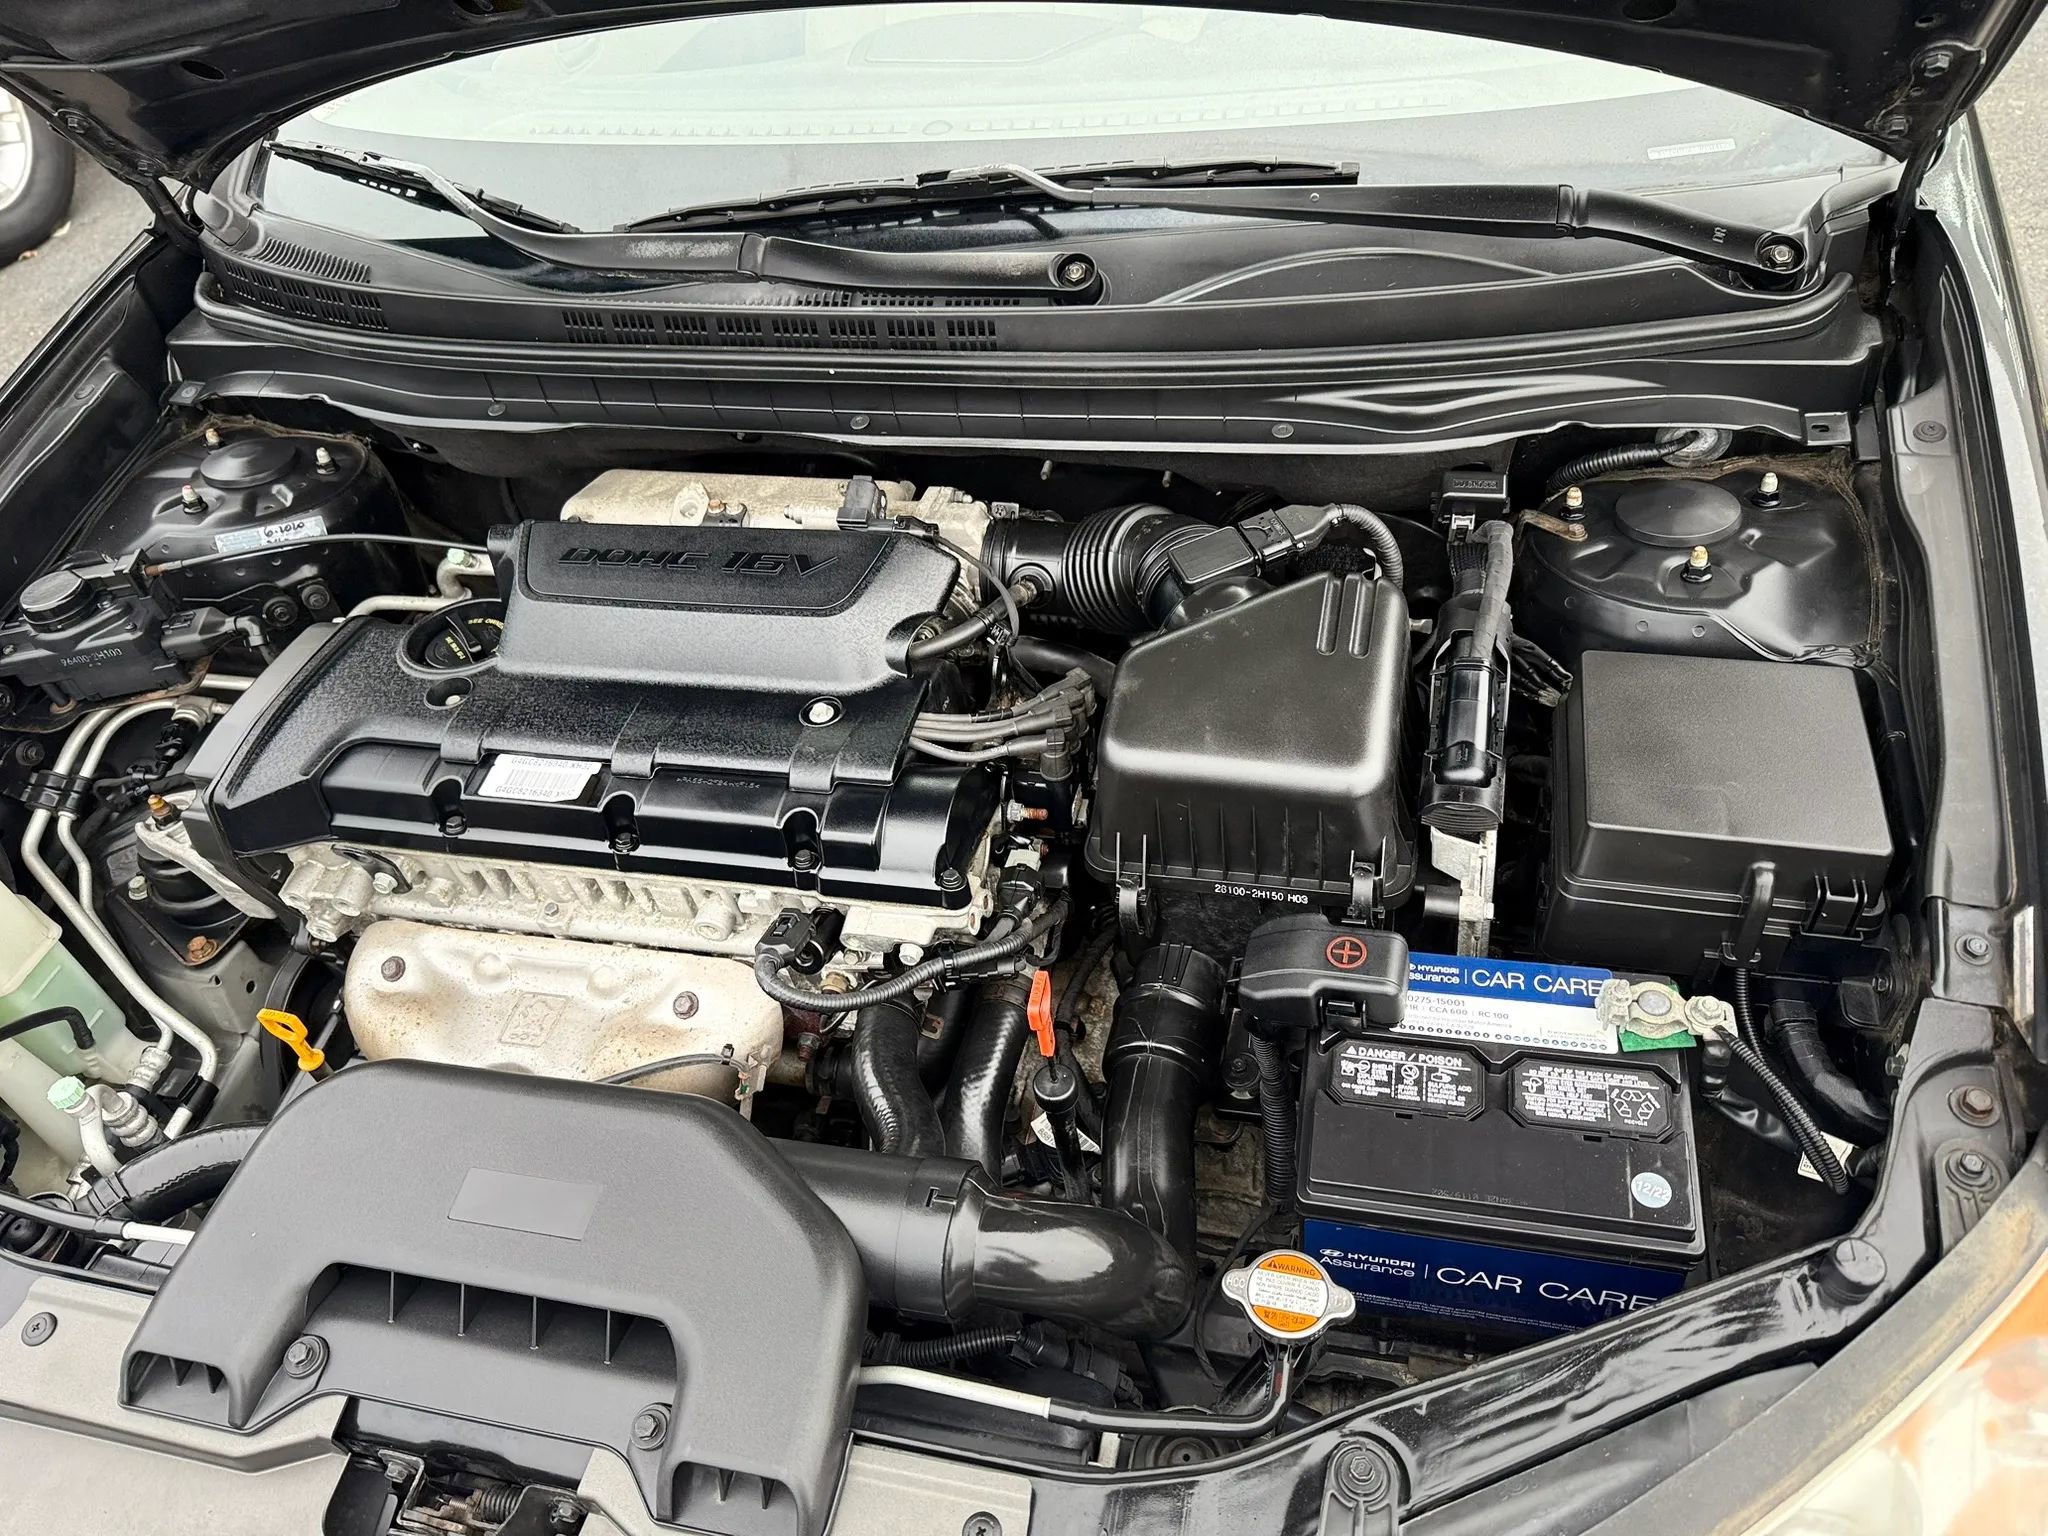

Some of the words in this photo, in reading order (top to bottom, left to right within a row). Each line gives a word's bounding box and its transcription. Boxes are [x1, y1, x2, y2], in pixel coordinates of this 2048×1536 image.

[557, 548, 710, 571] DOHC
[721, 551, 839, 577] 16V
[1287, 893, 1309, 904] H03
[1417, 963, 1460, 975] HYUNDAI
[1409, 973, 1460, 985] ssurance
[1471, 968, 1525, 991] CAR
[1533, 975, 1603, 997] CARE
[1407, 995, 1466, 1007] 0275-15001
[1428, 1005, 1448, 1015] CCA
[1478, 1010, 1492, 1018] RC
[1357, 1046, 1406, 1061] DANGER
[1418, 1053, 1463, 1068] POISON
[1636, 1179, 1672, 1201] 12/22
[1319, 1256, 1415, 1277] Assurance
[1347, 1252, 1416, 1268] HYUNDAI
[1277, 1263, 1316, 1277] WARNING
[1436, 1267, 1523, 1294] CAR
[1538, 1282, 1658, 1312] CARE
